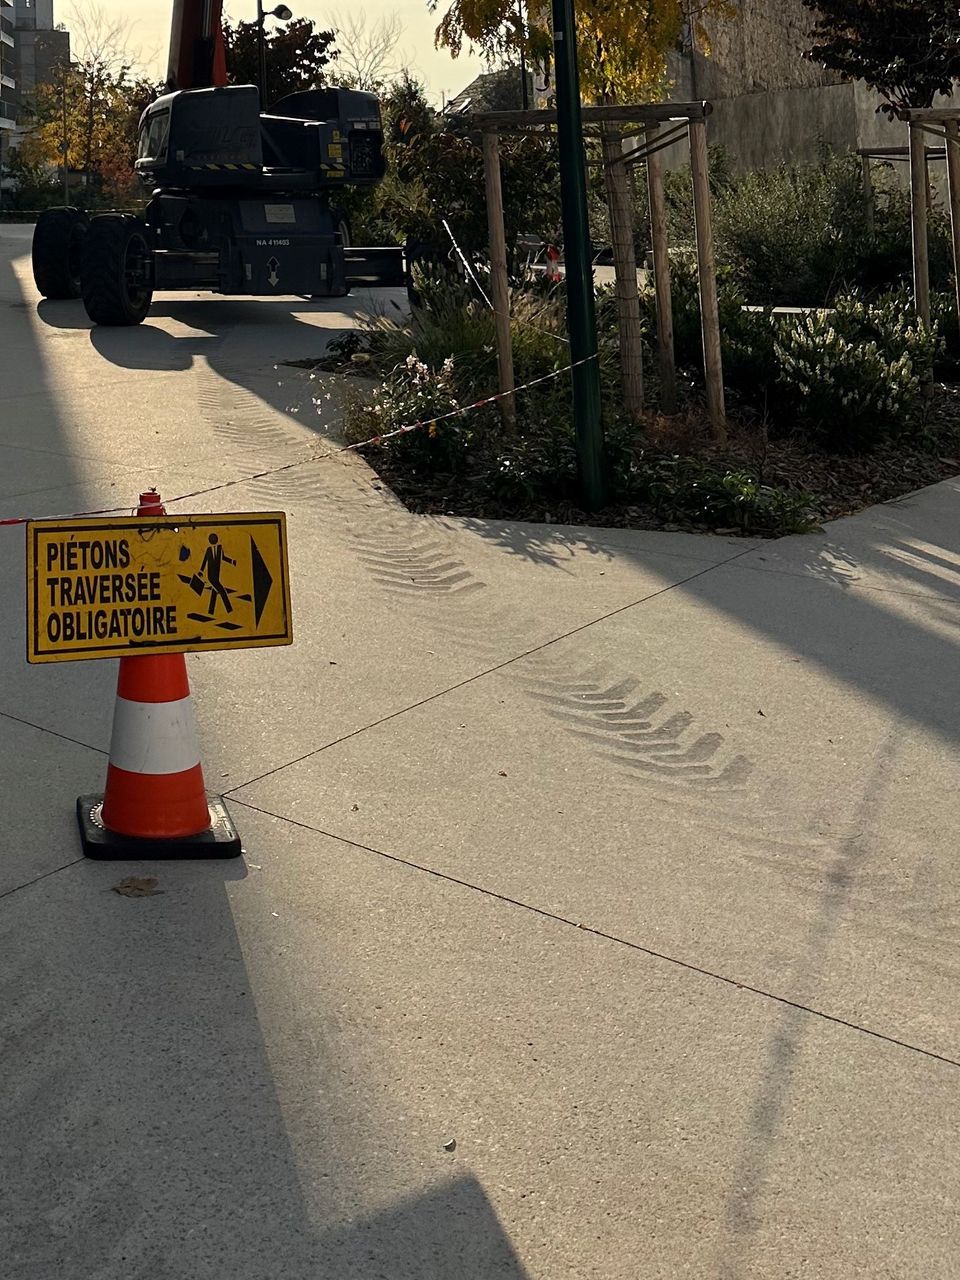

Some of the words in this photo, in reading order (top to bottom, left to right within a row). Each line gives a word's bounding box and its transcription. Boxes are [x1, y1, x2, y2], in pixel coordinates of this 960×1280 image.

[46, 535, 130, 571] PIÉTONS
[46, 566, 161, 607] TRAVERSÉE
[46, 605, 178, 643] OBLIGATOIRE
